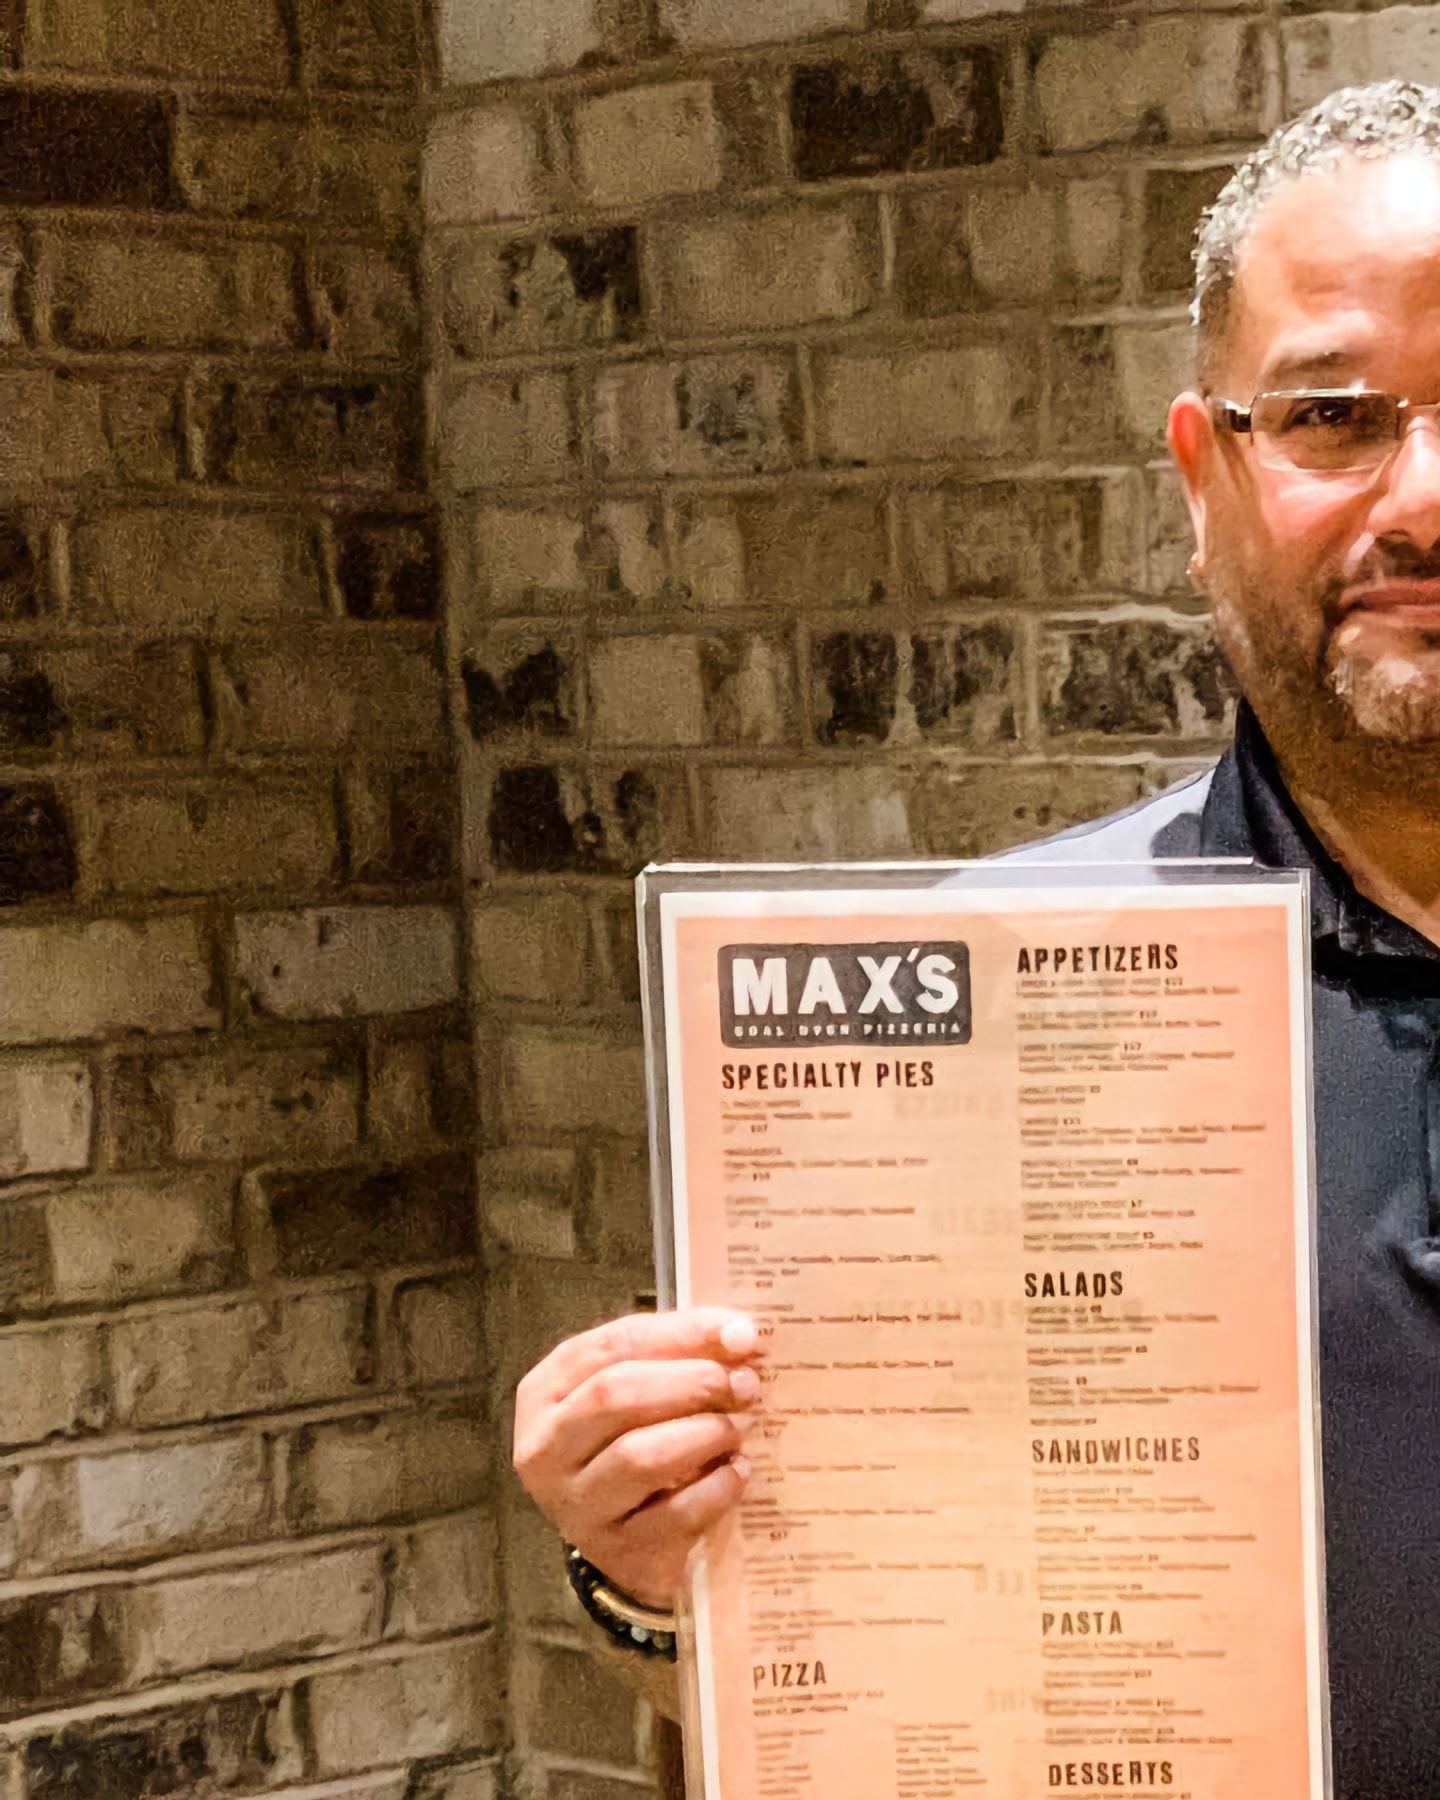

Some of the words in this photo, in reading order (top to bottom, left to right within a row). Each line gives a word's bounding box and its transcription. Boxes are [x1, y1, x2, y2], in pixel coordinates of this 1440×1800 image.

[1017, 943, 1180, 973] APPETIZERS
[732, 947, 959, 1016] MAX'S
[721, 1061, 863, 1091] SPECIALTY
[876, 1061, 935, 1088] PIES
[1024, 1270, 1124, 1298] SALADS
[1031, 1436, 1201, 1465] SANDWICHES
[1041, 1610, 1123, 1636] PASTA
[752, 1660, 827, 1690] PIZZA
[1048, 1760, 1174, 1786] DESSERTS
